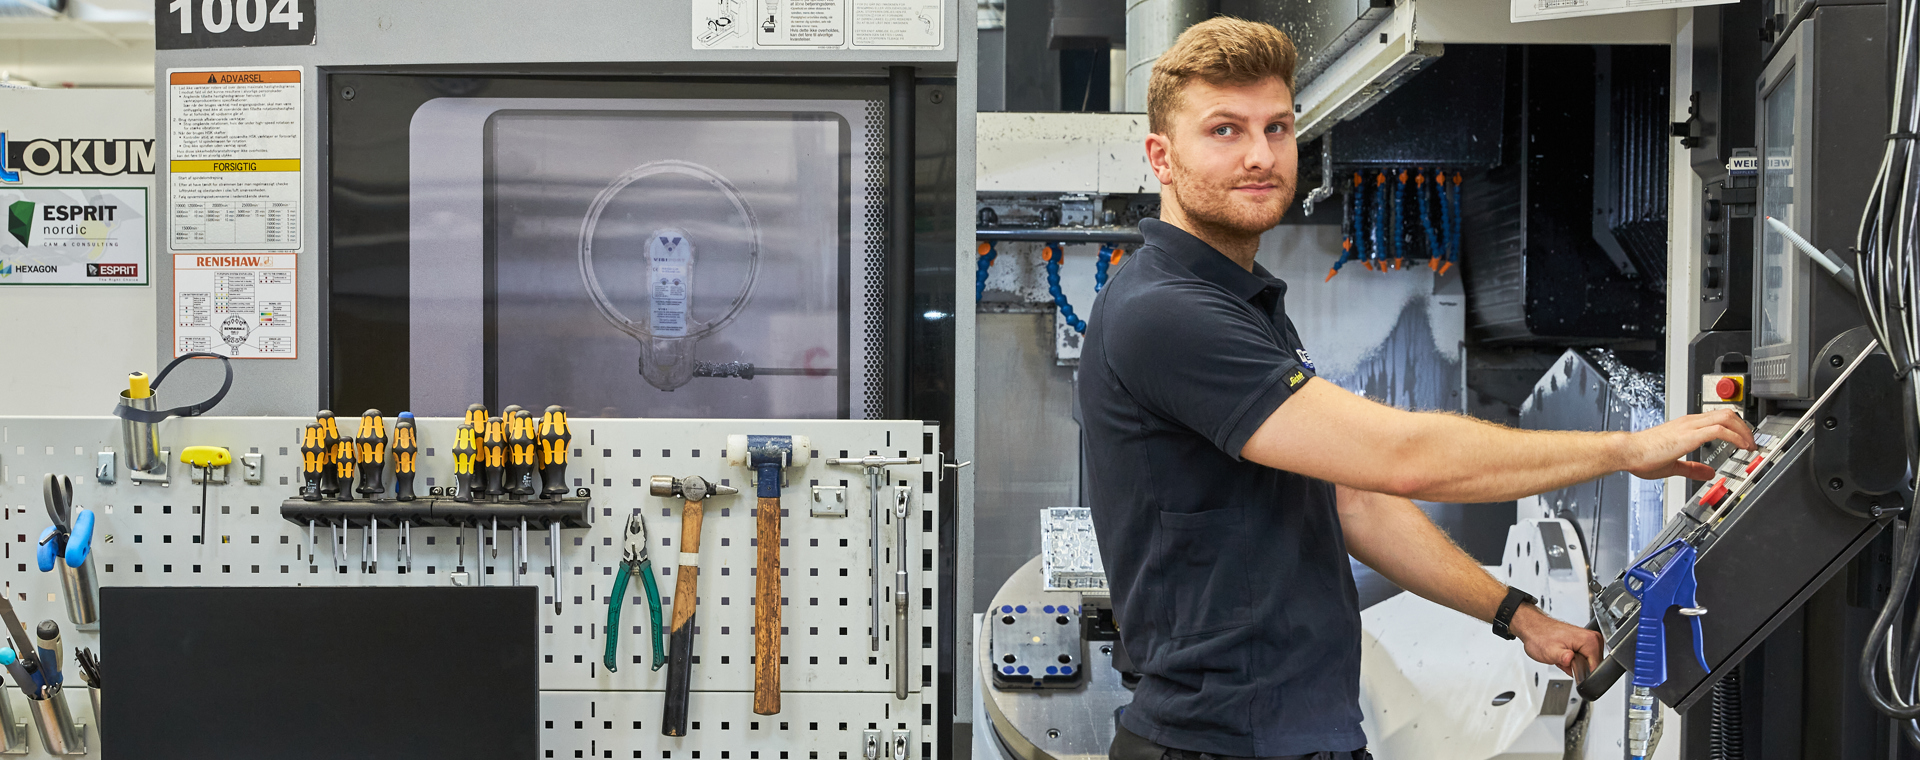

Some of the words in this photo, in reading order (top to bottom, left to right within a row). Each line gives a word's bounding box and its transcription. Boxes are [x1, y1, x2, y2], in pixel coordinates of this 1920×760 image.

[169, 0, 303, 34] 1004
[220, 74, 264, 83] ADVARSEL
[213, 162, 257, 171] FORSIGTIG
[43, 205, 118, 221] ESPRIT
[43, 224, 87, 235] nordic
[196, 256, 261, 267] RENISHAW
[15, 265, 58, 273] HEXAGON
[100, 265, 137, 275] ESPRIT
